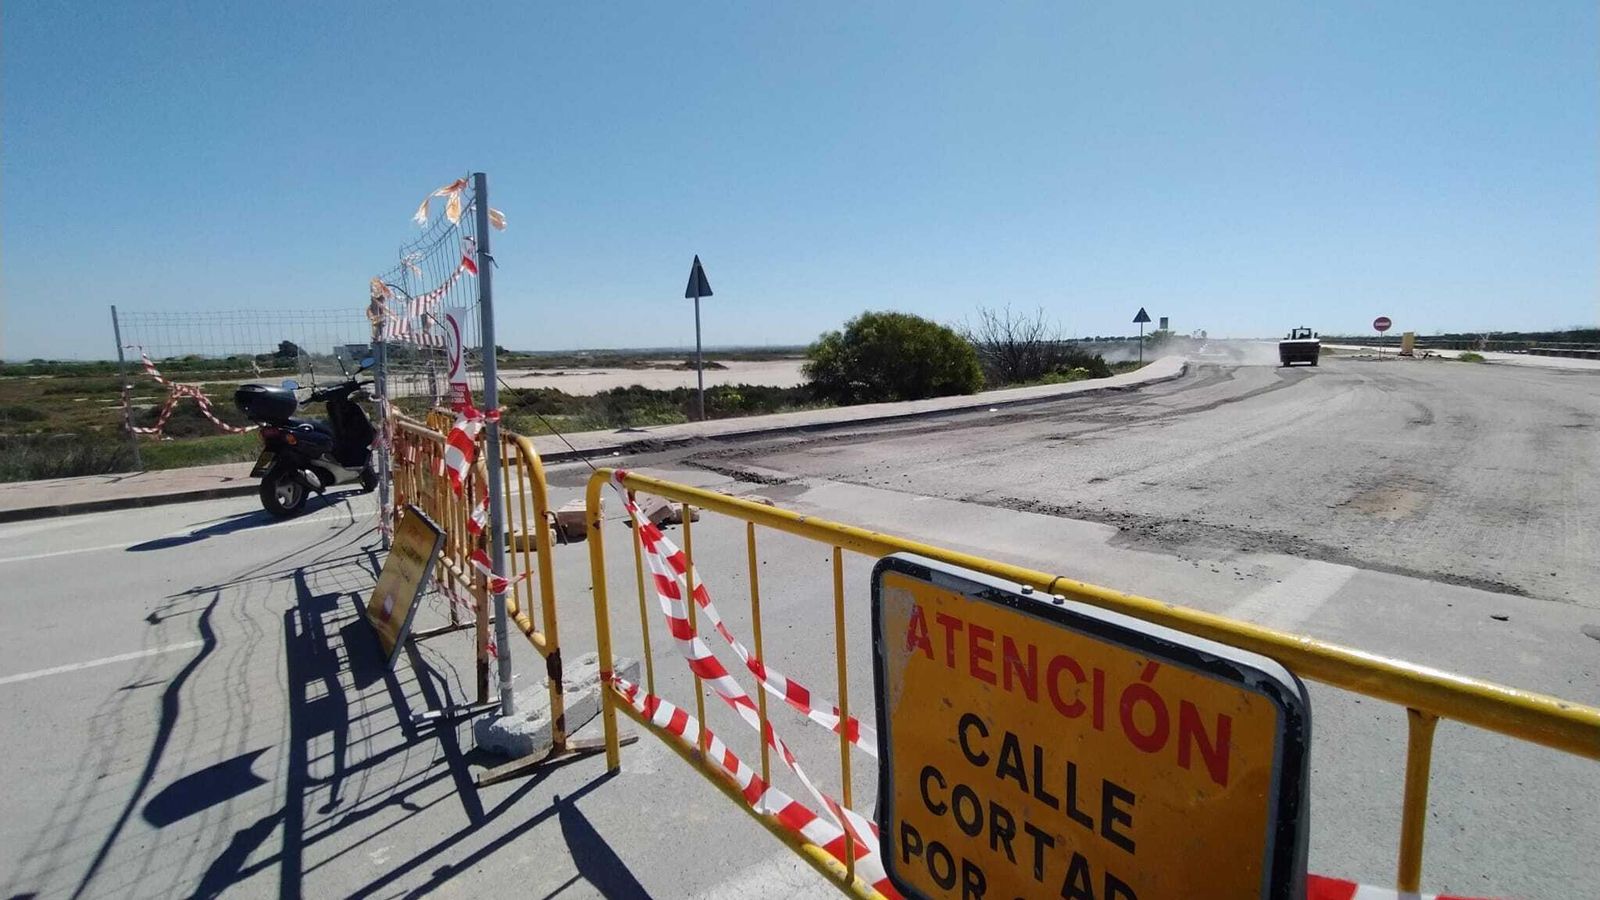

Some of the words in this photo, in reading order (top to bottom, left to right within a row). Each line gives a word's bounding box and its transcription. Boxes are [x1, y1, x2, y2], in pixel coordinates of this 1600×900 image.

[905, 604, 1233, 788] ATENCIÓN
[958, 712, 1136, 855] CALLE
[901, 820, 987, 900] POR
